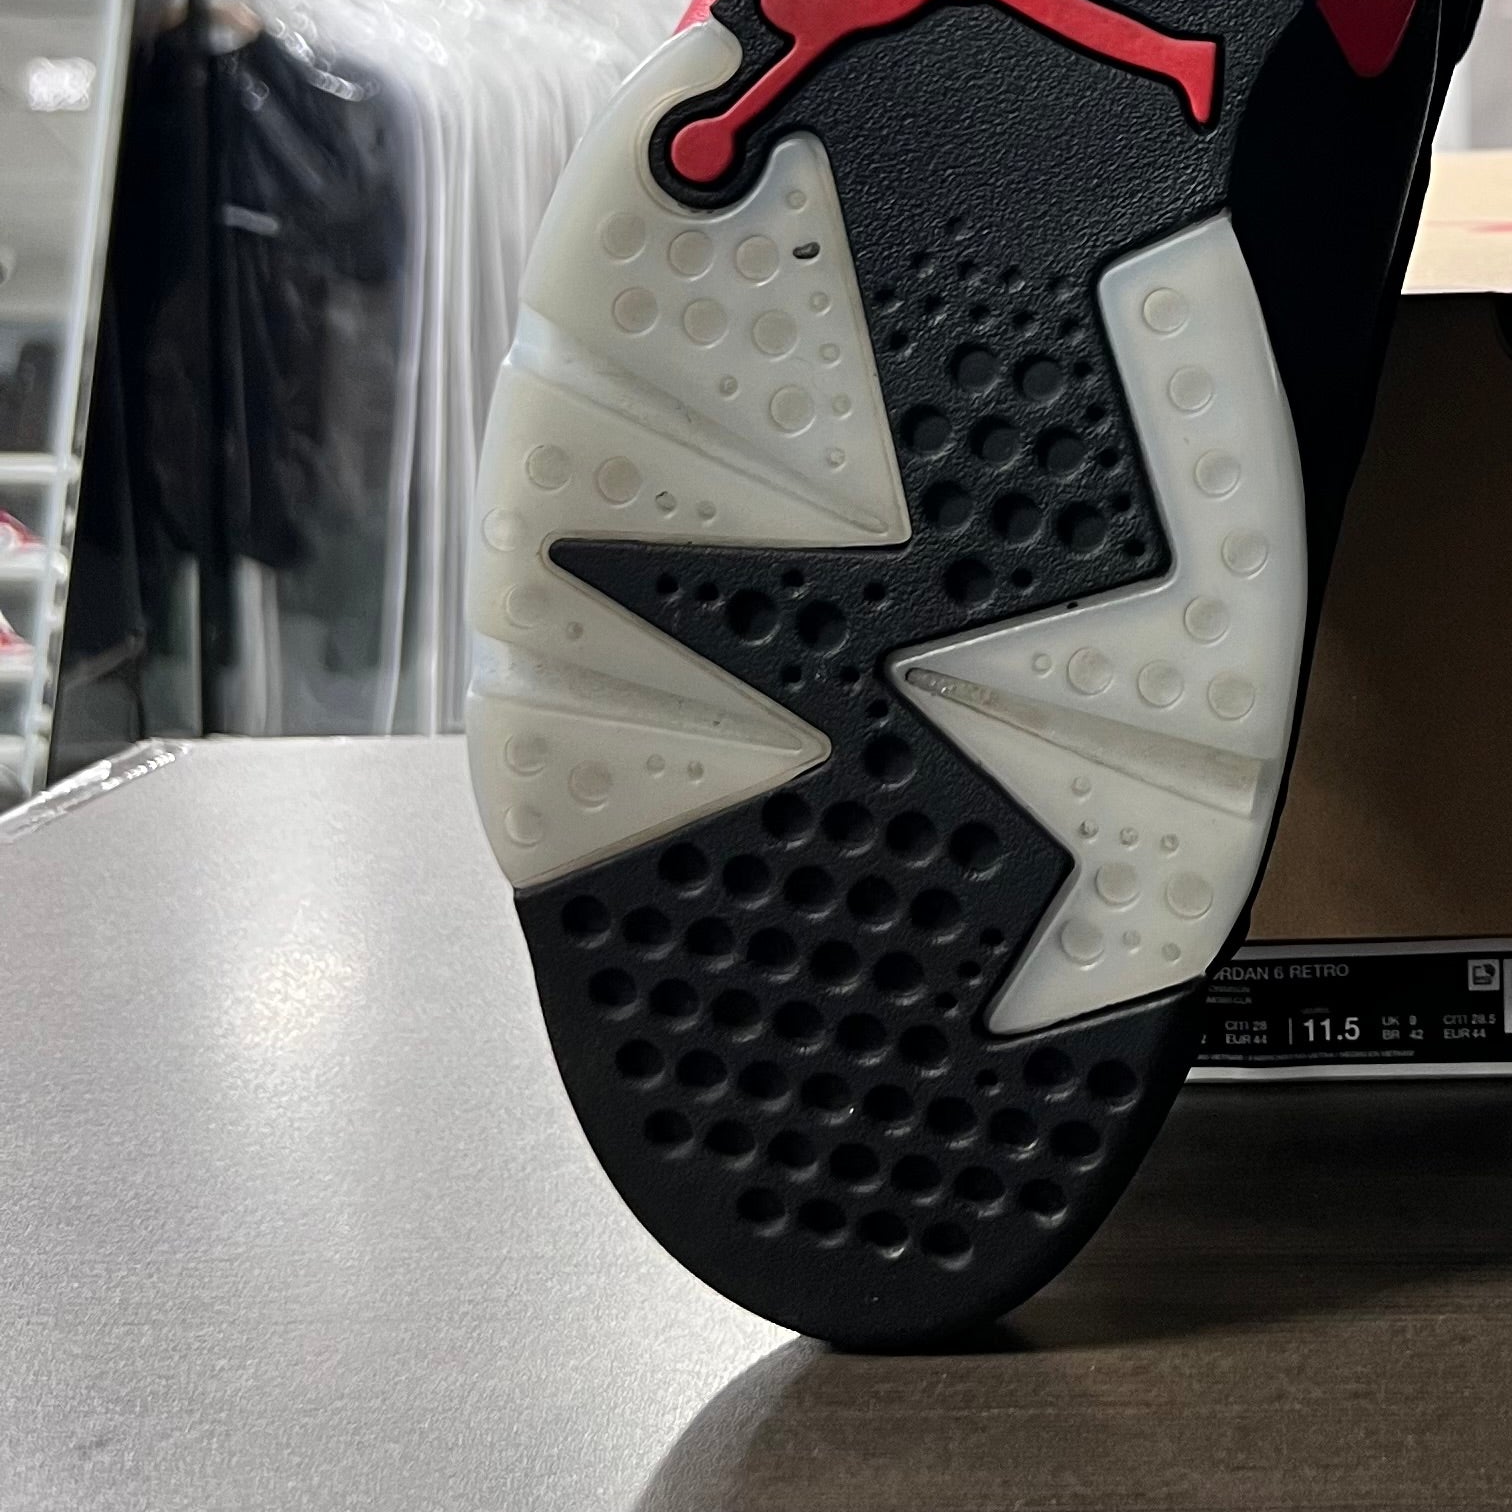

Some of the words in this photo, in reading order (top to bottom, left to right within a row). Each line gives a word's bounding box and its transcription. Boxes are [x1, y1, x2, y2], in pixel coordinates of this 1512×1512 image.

[1273, 965, 1285, 980] 6
[1289, 963, 1350, 979] RETRO
[1381, 1015, 1400, 1026] UK
[1303, 1016, 1361, 1042] 11.5
[1382, 1029, 1400, 1040] BR
[1443, 1028, 1471, 1039] EUR
[1225, 1033, 1251, 1045] EUR
